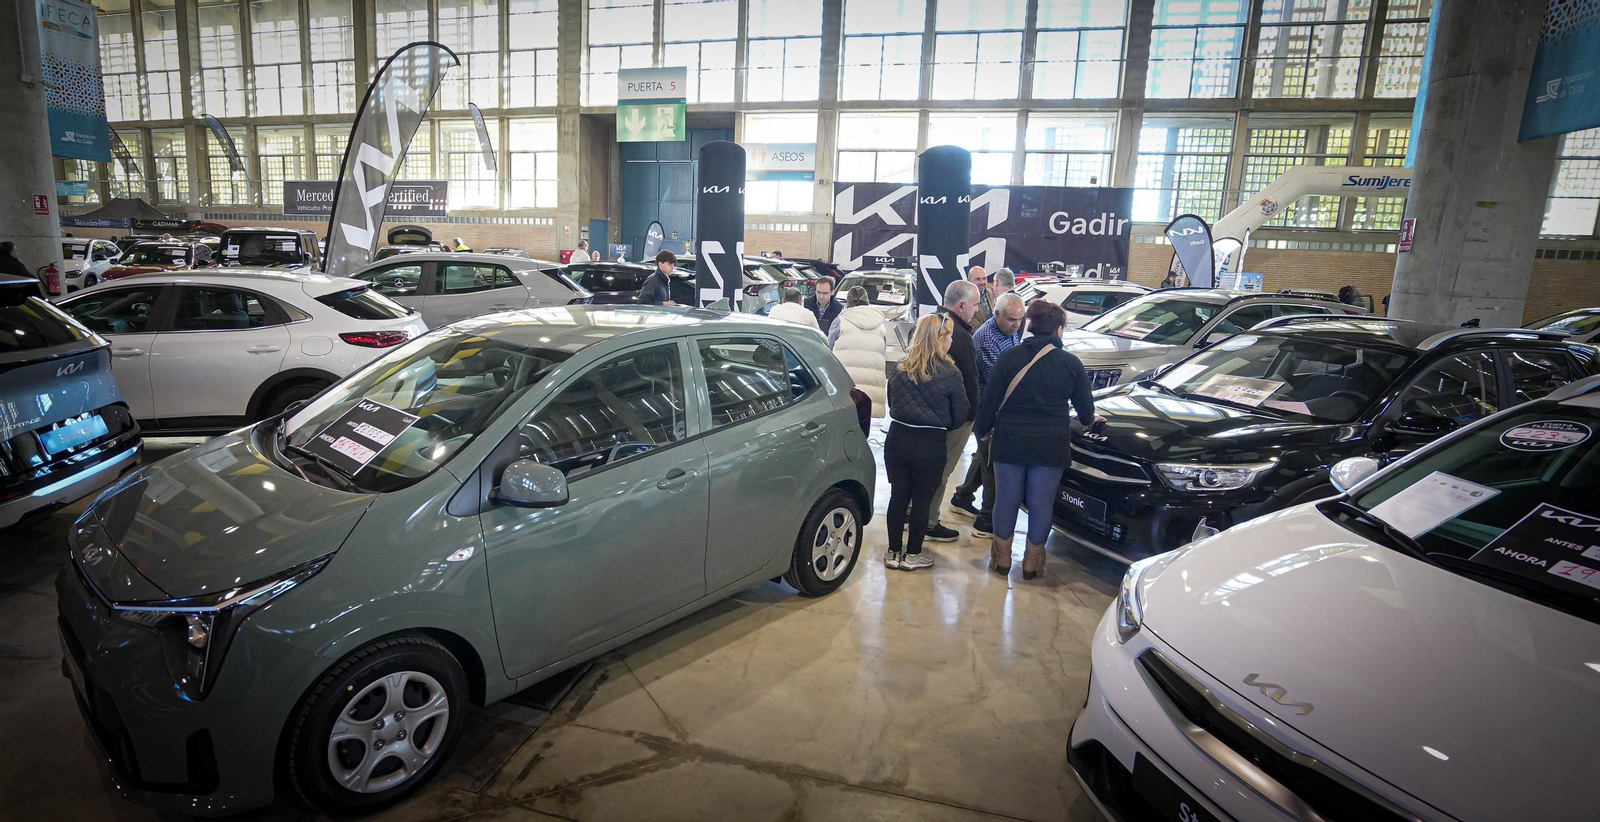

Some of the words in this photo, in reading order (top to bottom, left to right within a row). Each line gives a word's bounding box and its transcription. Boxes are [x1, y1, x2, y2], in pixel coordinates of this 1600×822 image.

[41, 3, 92, 29] IFECA
[627, 81, 663, 92] PUERTA
[670, 81, 676, 91] 5
[772, 152, 805, 161] ASEOS
[1342, 175, 1412, 190] SumiJere
[296, 189, 334, 202] Merced
[388, 189, 430, 203] ertified
[703, 186, 730, 194] KIA
[920, 196, 947, 204] KIA
[1048, 211, 1129, 237] Gadir
[57, 361, 85, 377] KIA
[358, 402, 381, 413] KIA
[1083, 431, 1108, 442] KIA
[1512, 440, 1553, 448] KIA
[1061, 491, 1085, 508] Stonic
[1544, 537, 1584, 551] ANTES
[1494, 549, 1548, 568] AHORA
[1242, 673, 1315, 715] KIA
